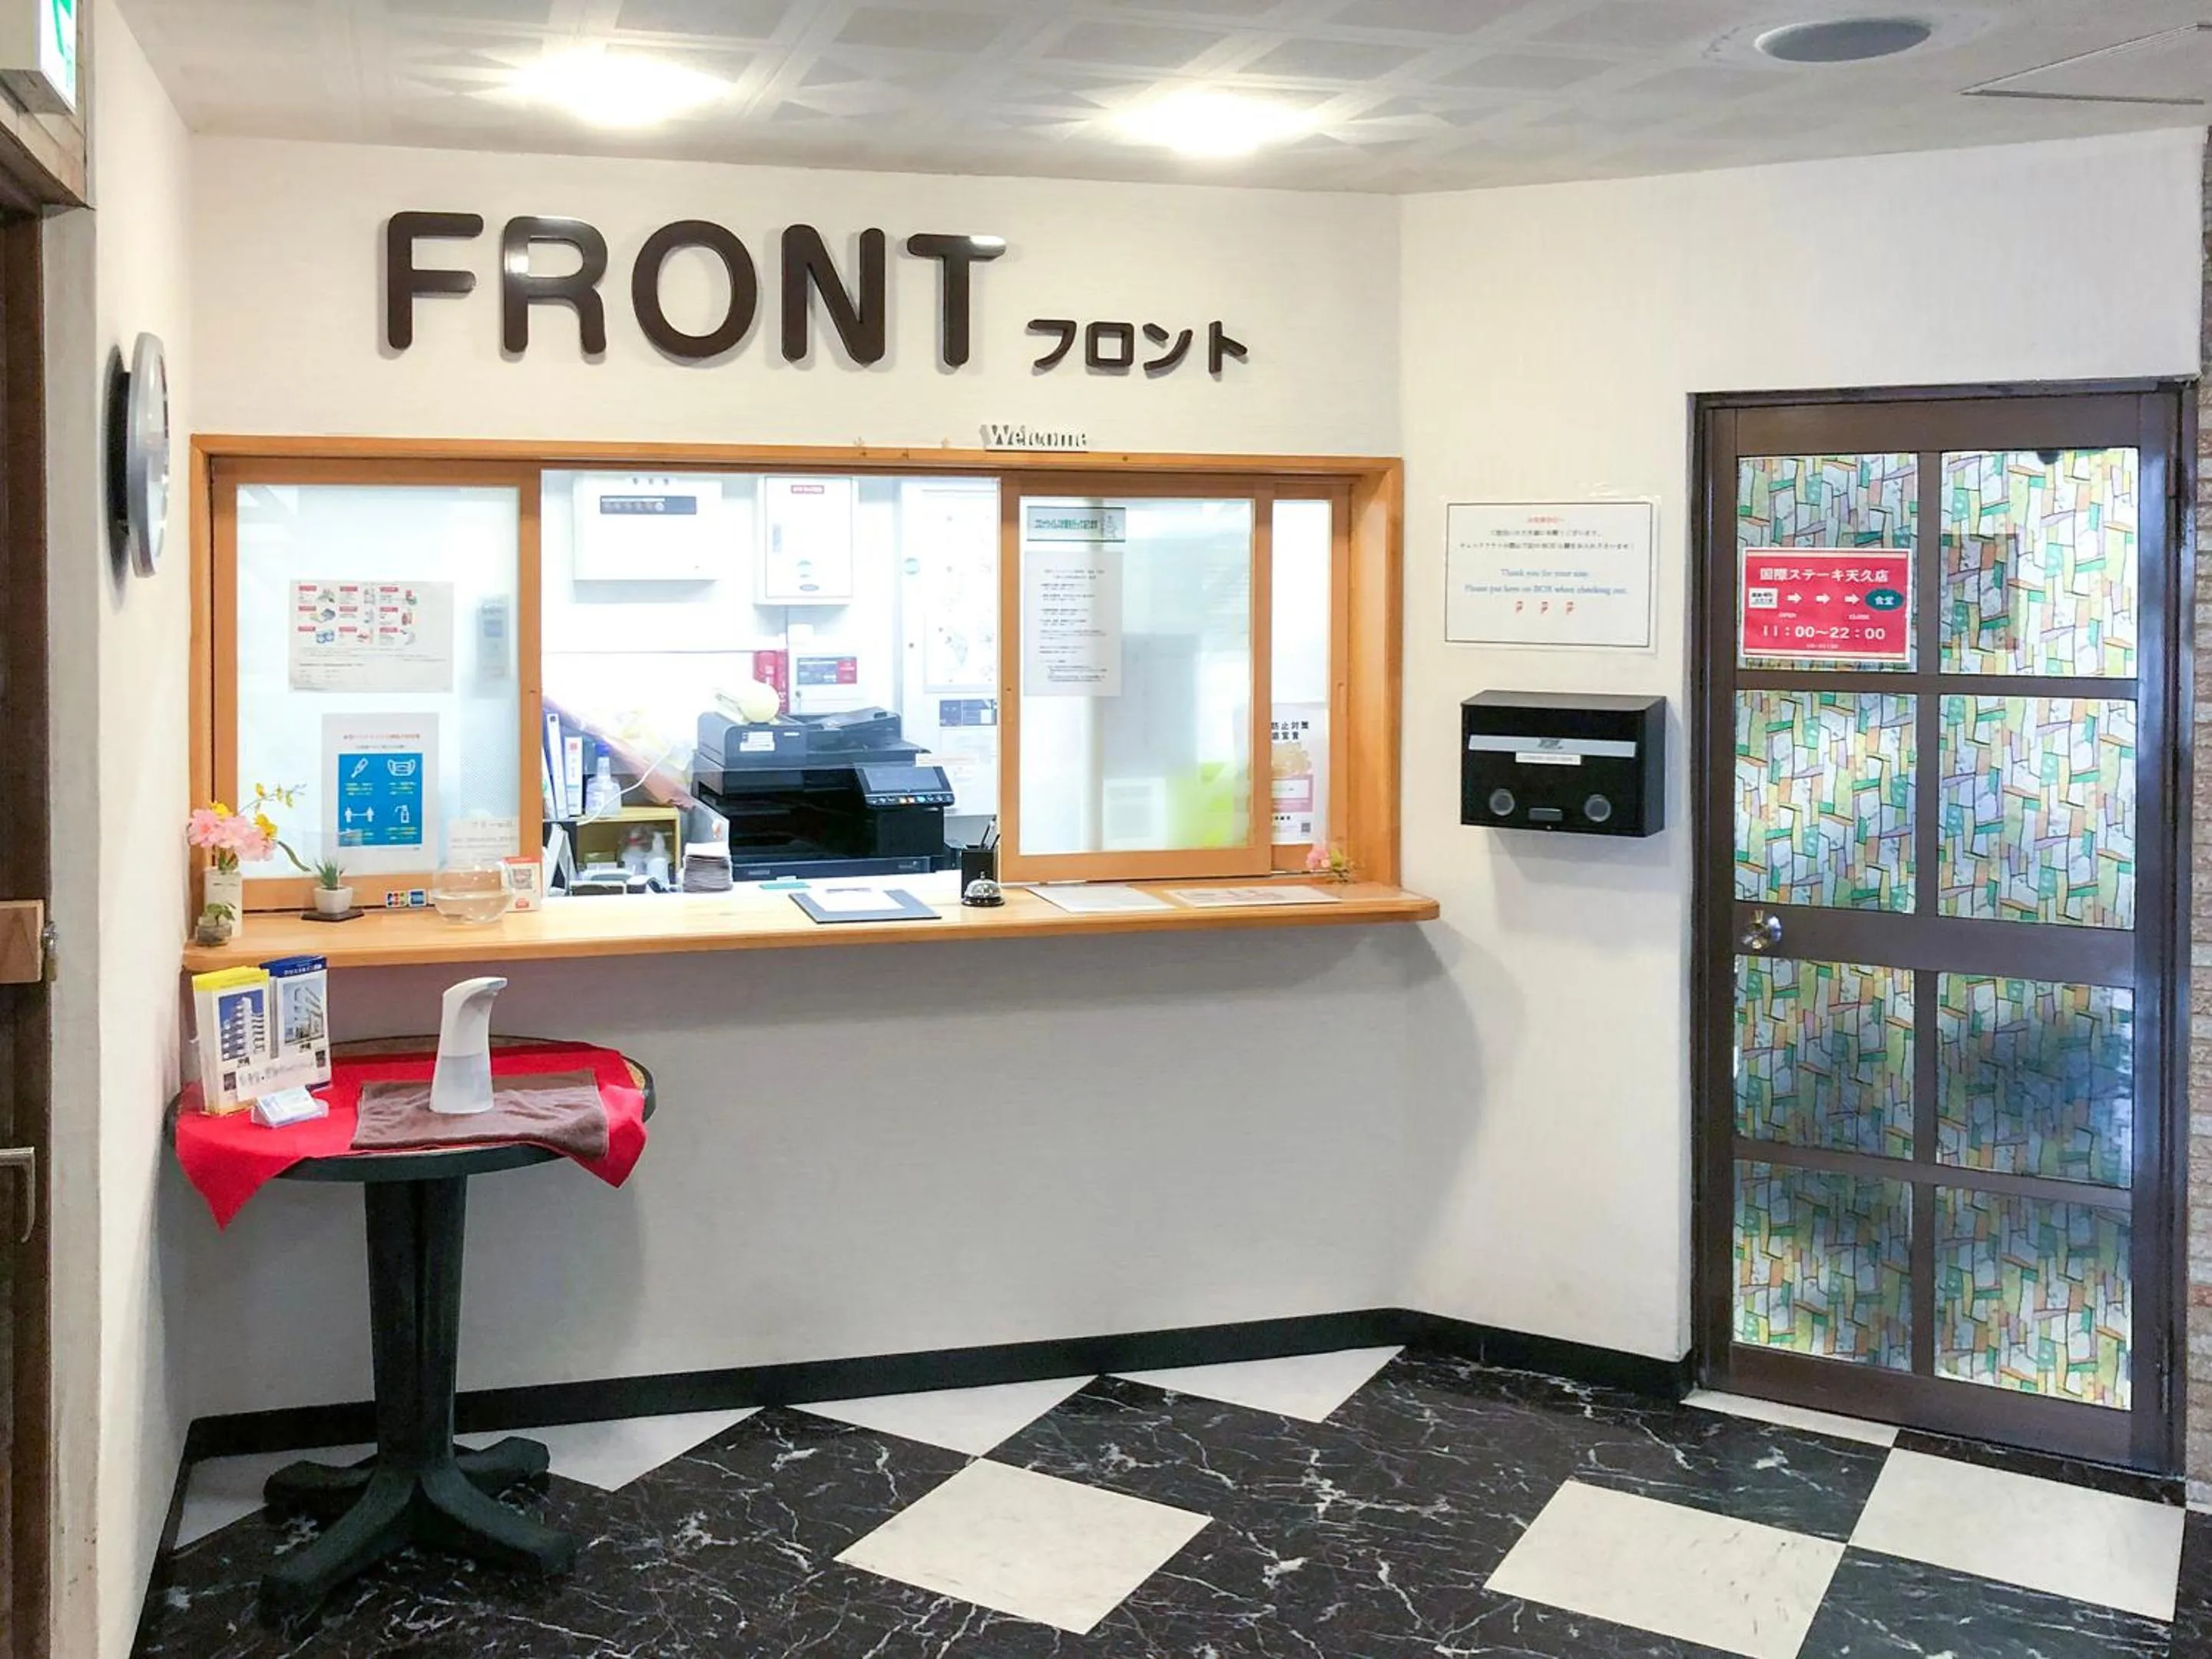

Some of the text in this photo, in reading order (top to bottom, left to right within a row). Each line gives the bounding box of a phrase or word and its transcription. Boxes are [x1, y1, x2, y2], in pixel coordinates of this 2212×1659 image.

[387, 210, 1007, 369] FRONT
[1026, 318, 1249, 375] フロント
[985, 423, 1088, 449] Welcome
[1760, 567, 1889, 583] 国際ステーキ天久店
[1534, 584, 1552, 593] BOX
